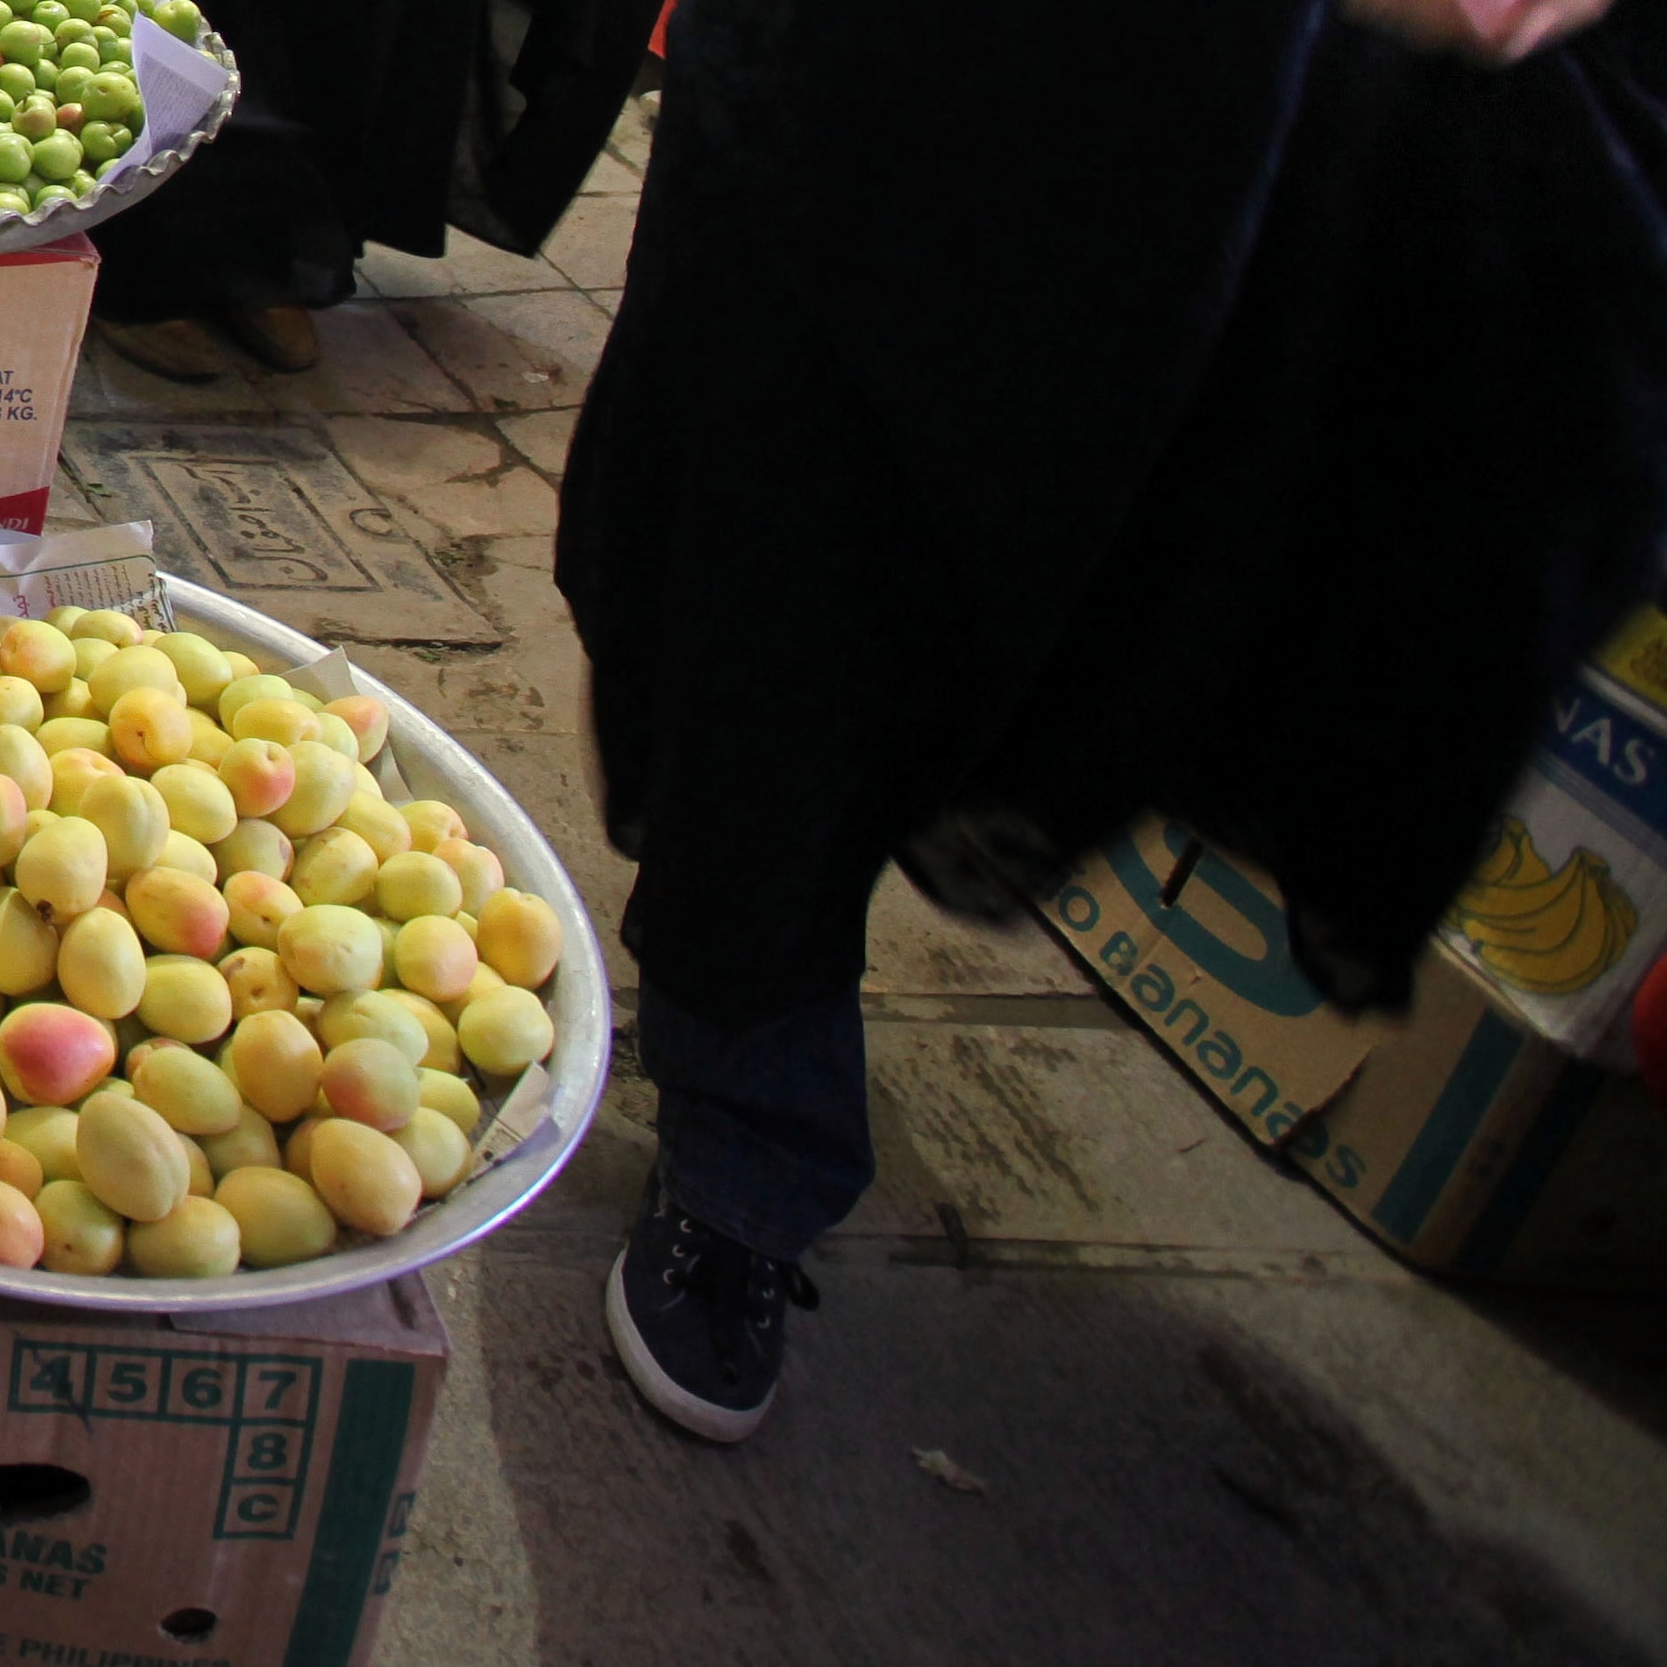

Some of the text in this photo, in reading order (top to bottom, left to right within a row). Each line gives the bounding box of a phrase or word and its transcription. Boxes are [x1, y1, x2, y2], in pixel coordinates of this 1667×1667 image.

[6, 406, 38, 421] KG.
[106, 1362, 148, 1403] 5
[180, 1367, 224, 1410] 6
[257, 1370, 298, 1410] 7
[245, 1431, 288, 1471] 8
[235, 1493, 280, 1524] C
[19, 1570, 91, 1601] NET
